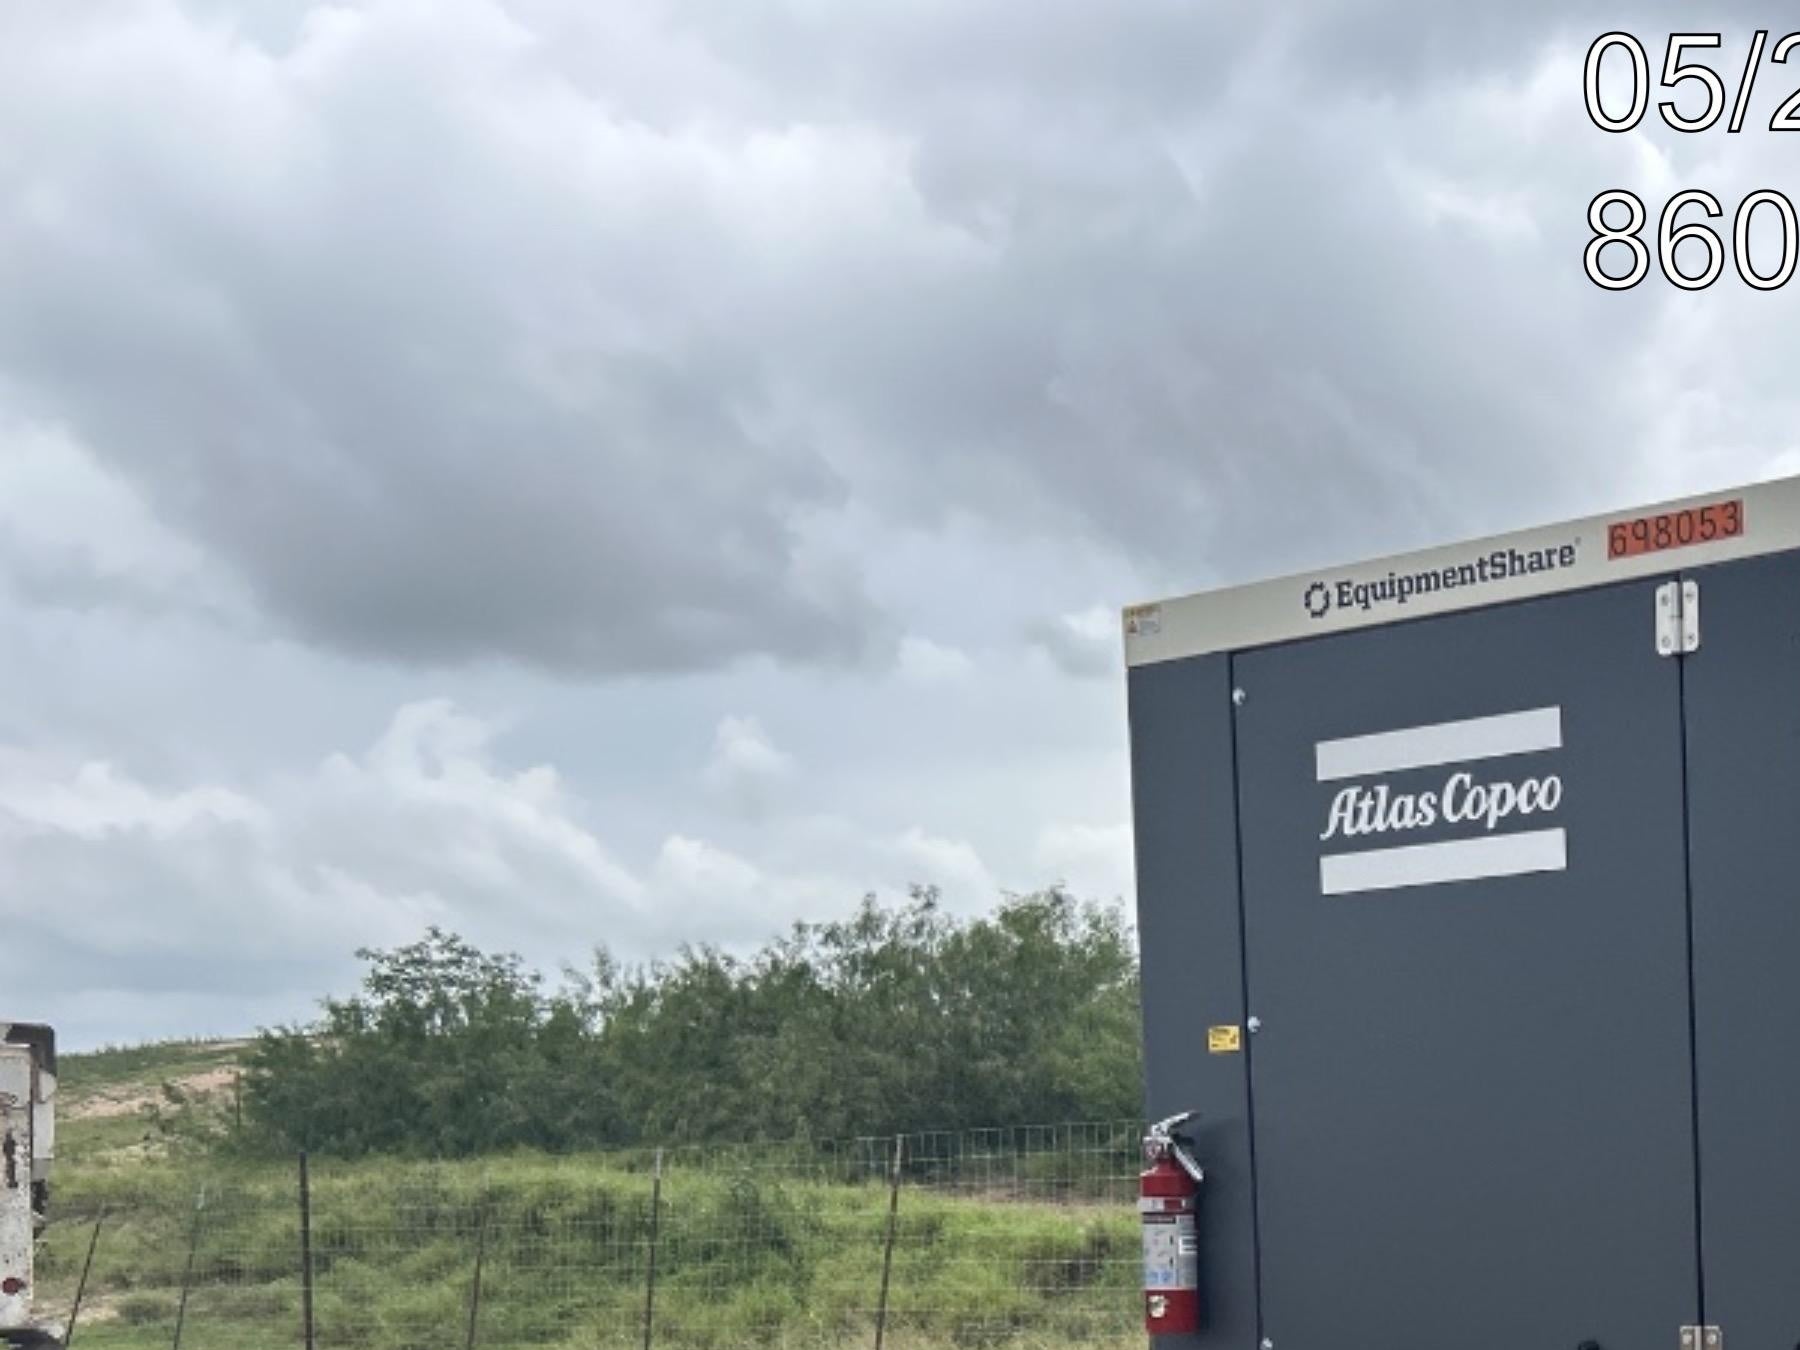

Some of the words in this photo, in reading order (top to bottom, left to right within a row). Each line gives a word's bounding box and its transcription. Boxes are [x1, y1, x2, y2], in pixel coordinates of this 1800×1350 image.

[1610, 501, 1743, 556] 698053
[1336, 542, 1578, 611] EquipmentShare
[1319, 784, 1438, 840] Atlas
[1442, 773, 1562, 830] Copco
